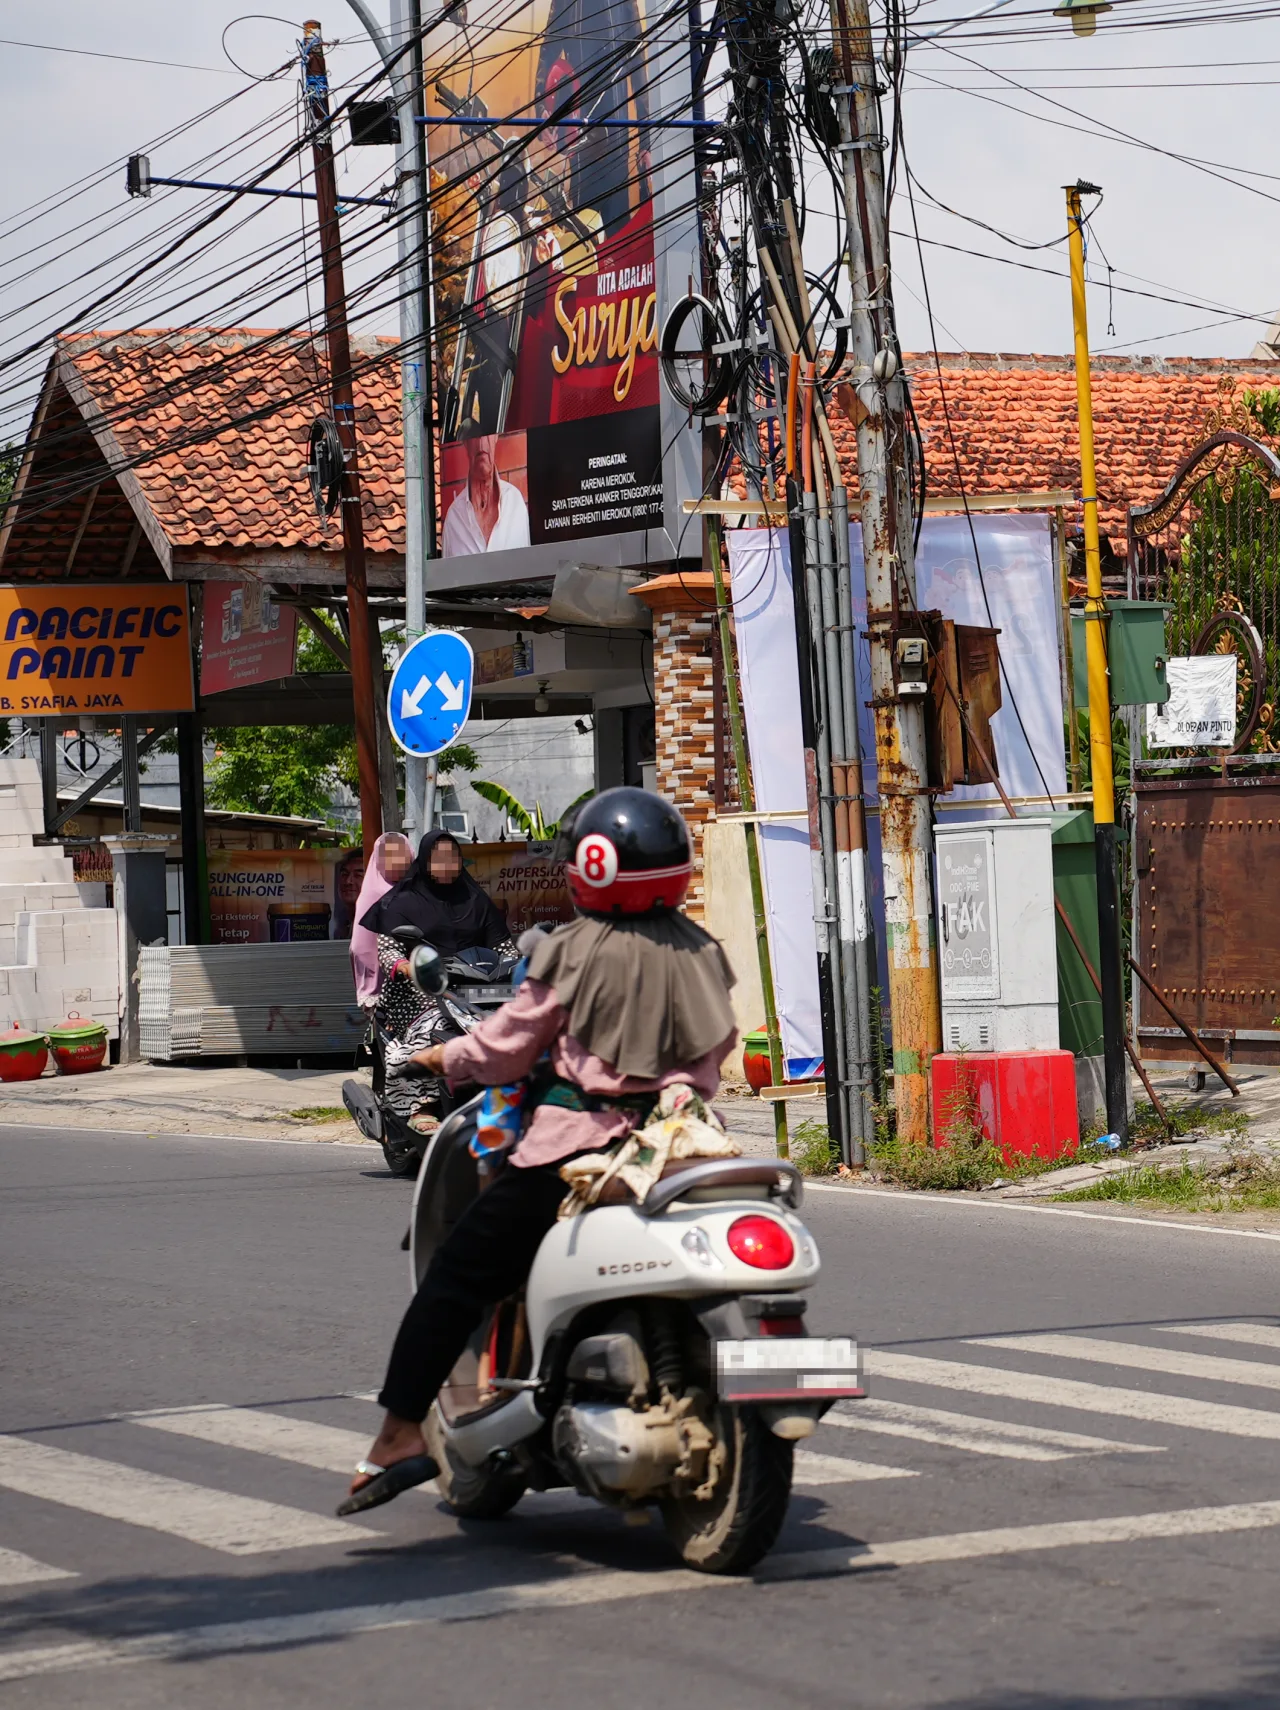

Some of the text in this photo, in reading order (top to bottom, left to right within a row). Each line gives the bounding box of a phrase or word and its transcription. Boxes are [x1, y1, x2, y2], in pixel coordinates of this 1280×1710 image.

[597, 262, 653, 296] KITA ADALAH
[551, 277, 658, 402] Surya
[589, 453, 627, 469] PERINGATAN:
[581, 472, 636, 490] KARENA MEROKOK,
[552, 499, 567, 511] SAYA
[567, 494, 593, 508] TERKENA
[595, 491, 619, 503] KANKER
[544, 516, 570, 529] LAYANAN
[572, 512, 600, 525] BERHENTI
[602, 507, 631, 521] MEROKOK
[5, 605, 183, 640] PACIFIC
[7, 645, 144, 679] PAINT
[21, 695, 78, 709] SYAFIA
[84, 694, 124, 707] JAYA
[1186, 722, 1208, 732] DEPAN
[1210, 721, 1231, 732] PINTU
[585, 845, 606, 881] 8
[208, 872, 284, 883] SUNGUARD
[499, 866, 566, 878] SUPERSILK
[209, 886, 285, 897] ALL-IN-ONE
[497, 880, 527, 892] ANTI
[531, 878, 568, 890] NODA
[218, 928, 250, 939] Tetap
[598, 1260, 672, 1275] SCOOPY
